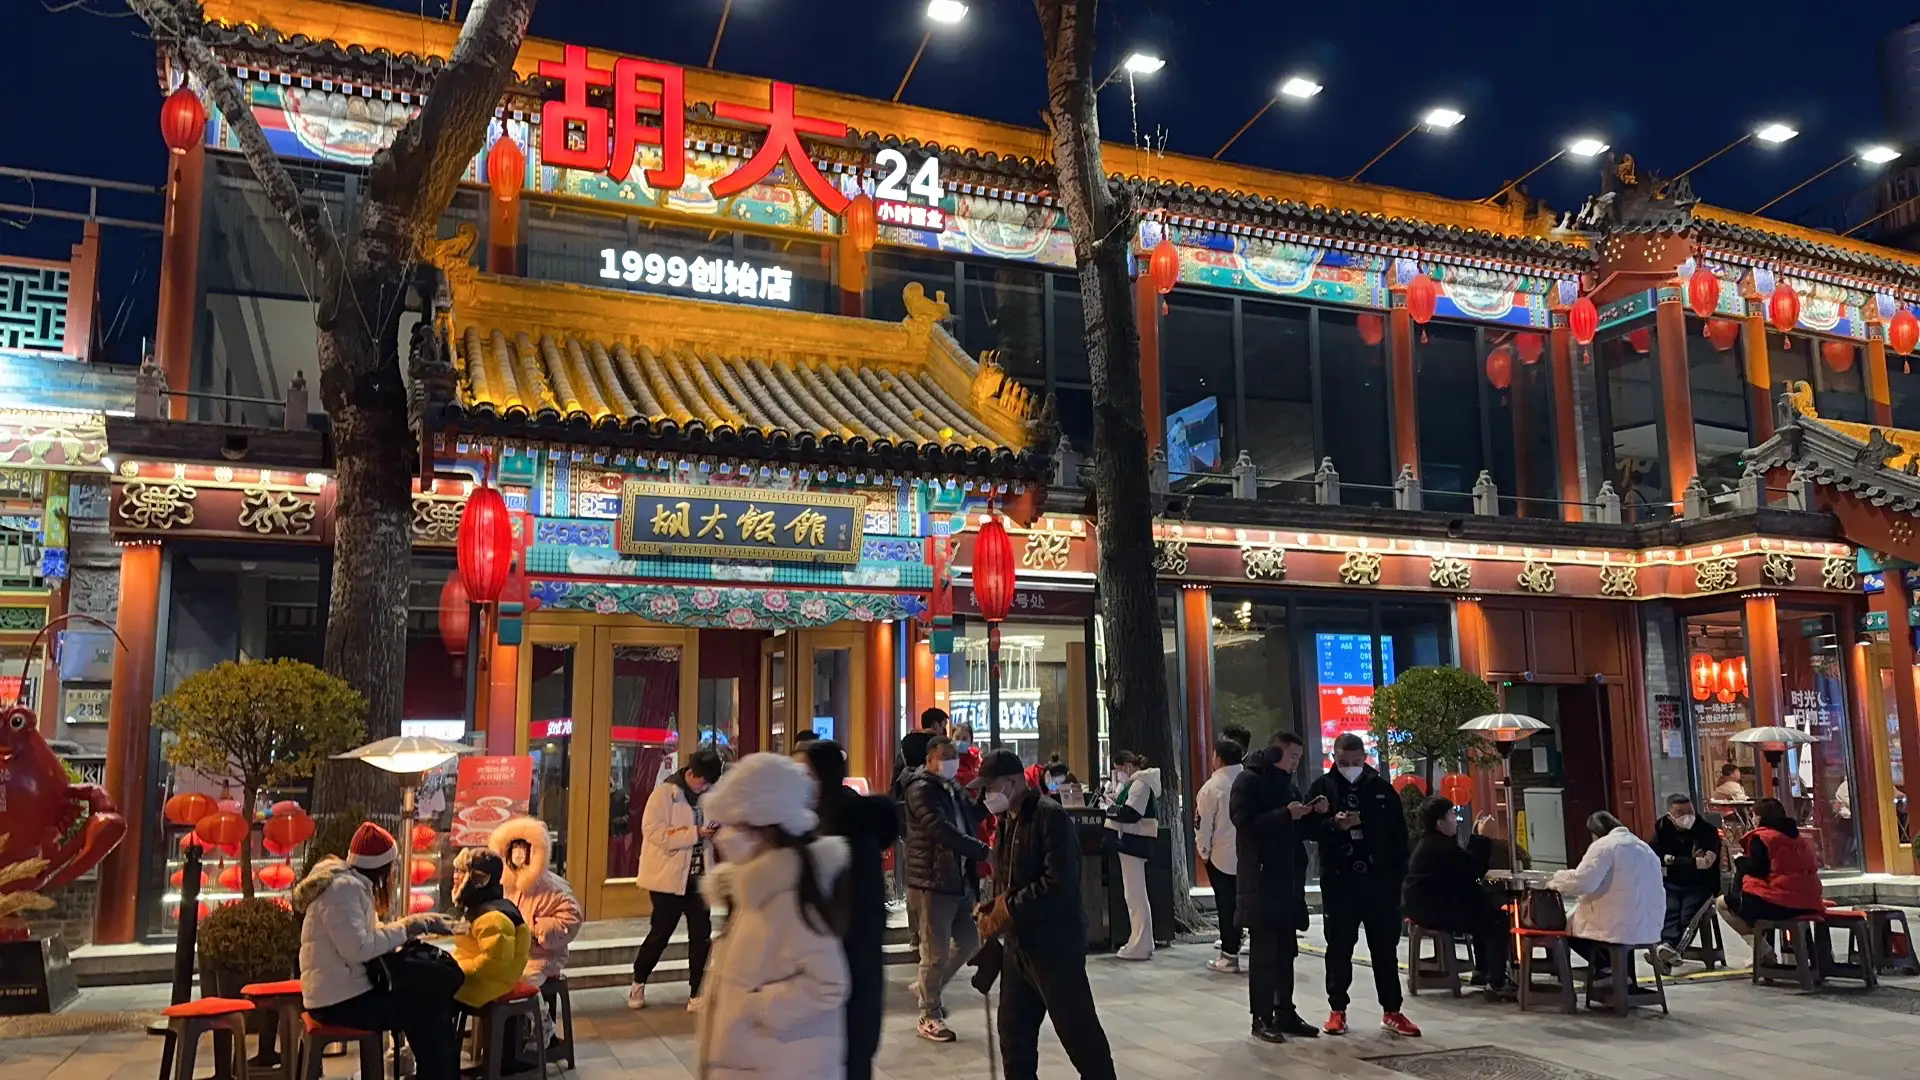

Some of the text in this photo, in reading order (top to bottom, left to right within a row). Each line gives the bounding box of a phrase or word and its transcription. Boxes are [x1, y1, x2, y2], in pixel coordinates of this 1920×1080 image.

[539, 44, 851, 214] 胡大
[875, 148, 945, 207] 24
[877, 201, 943, 228] 小时营业
[599, 248, 793, 302] 1999创始店
[78, 703, 102, 716] 235
